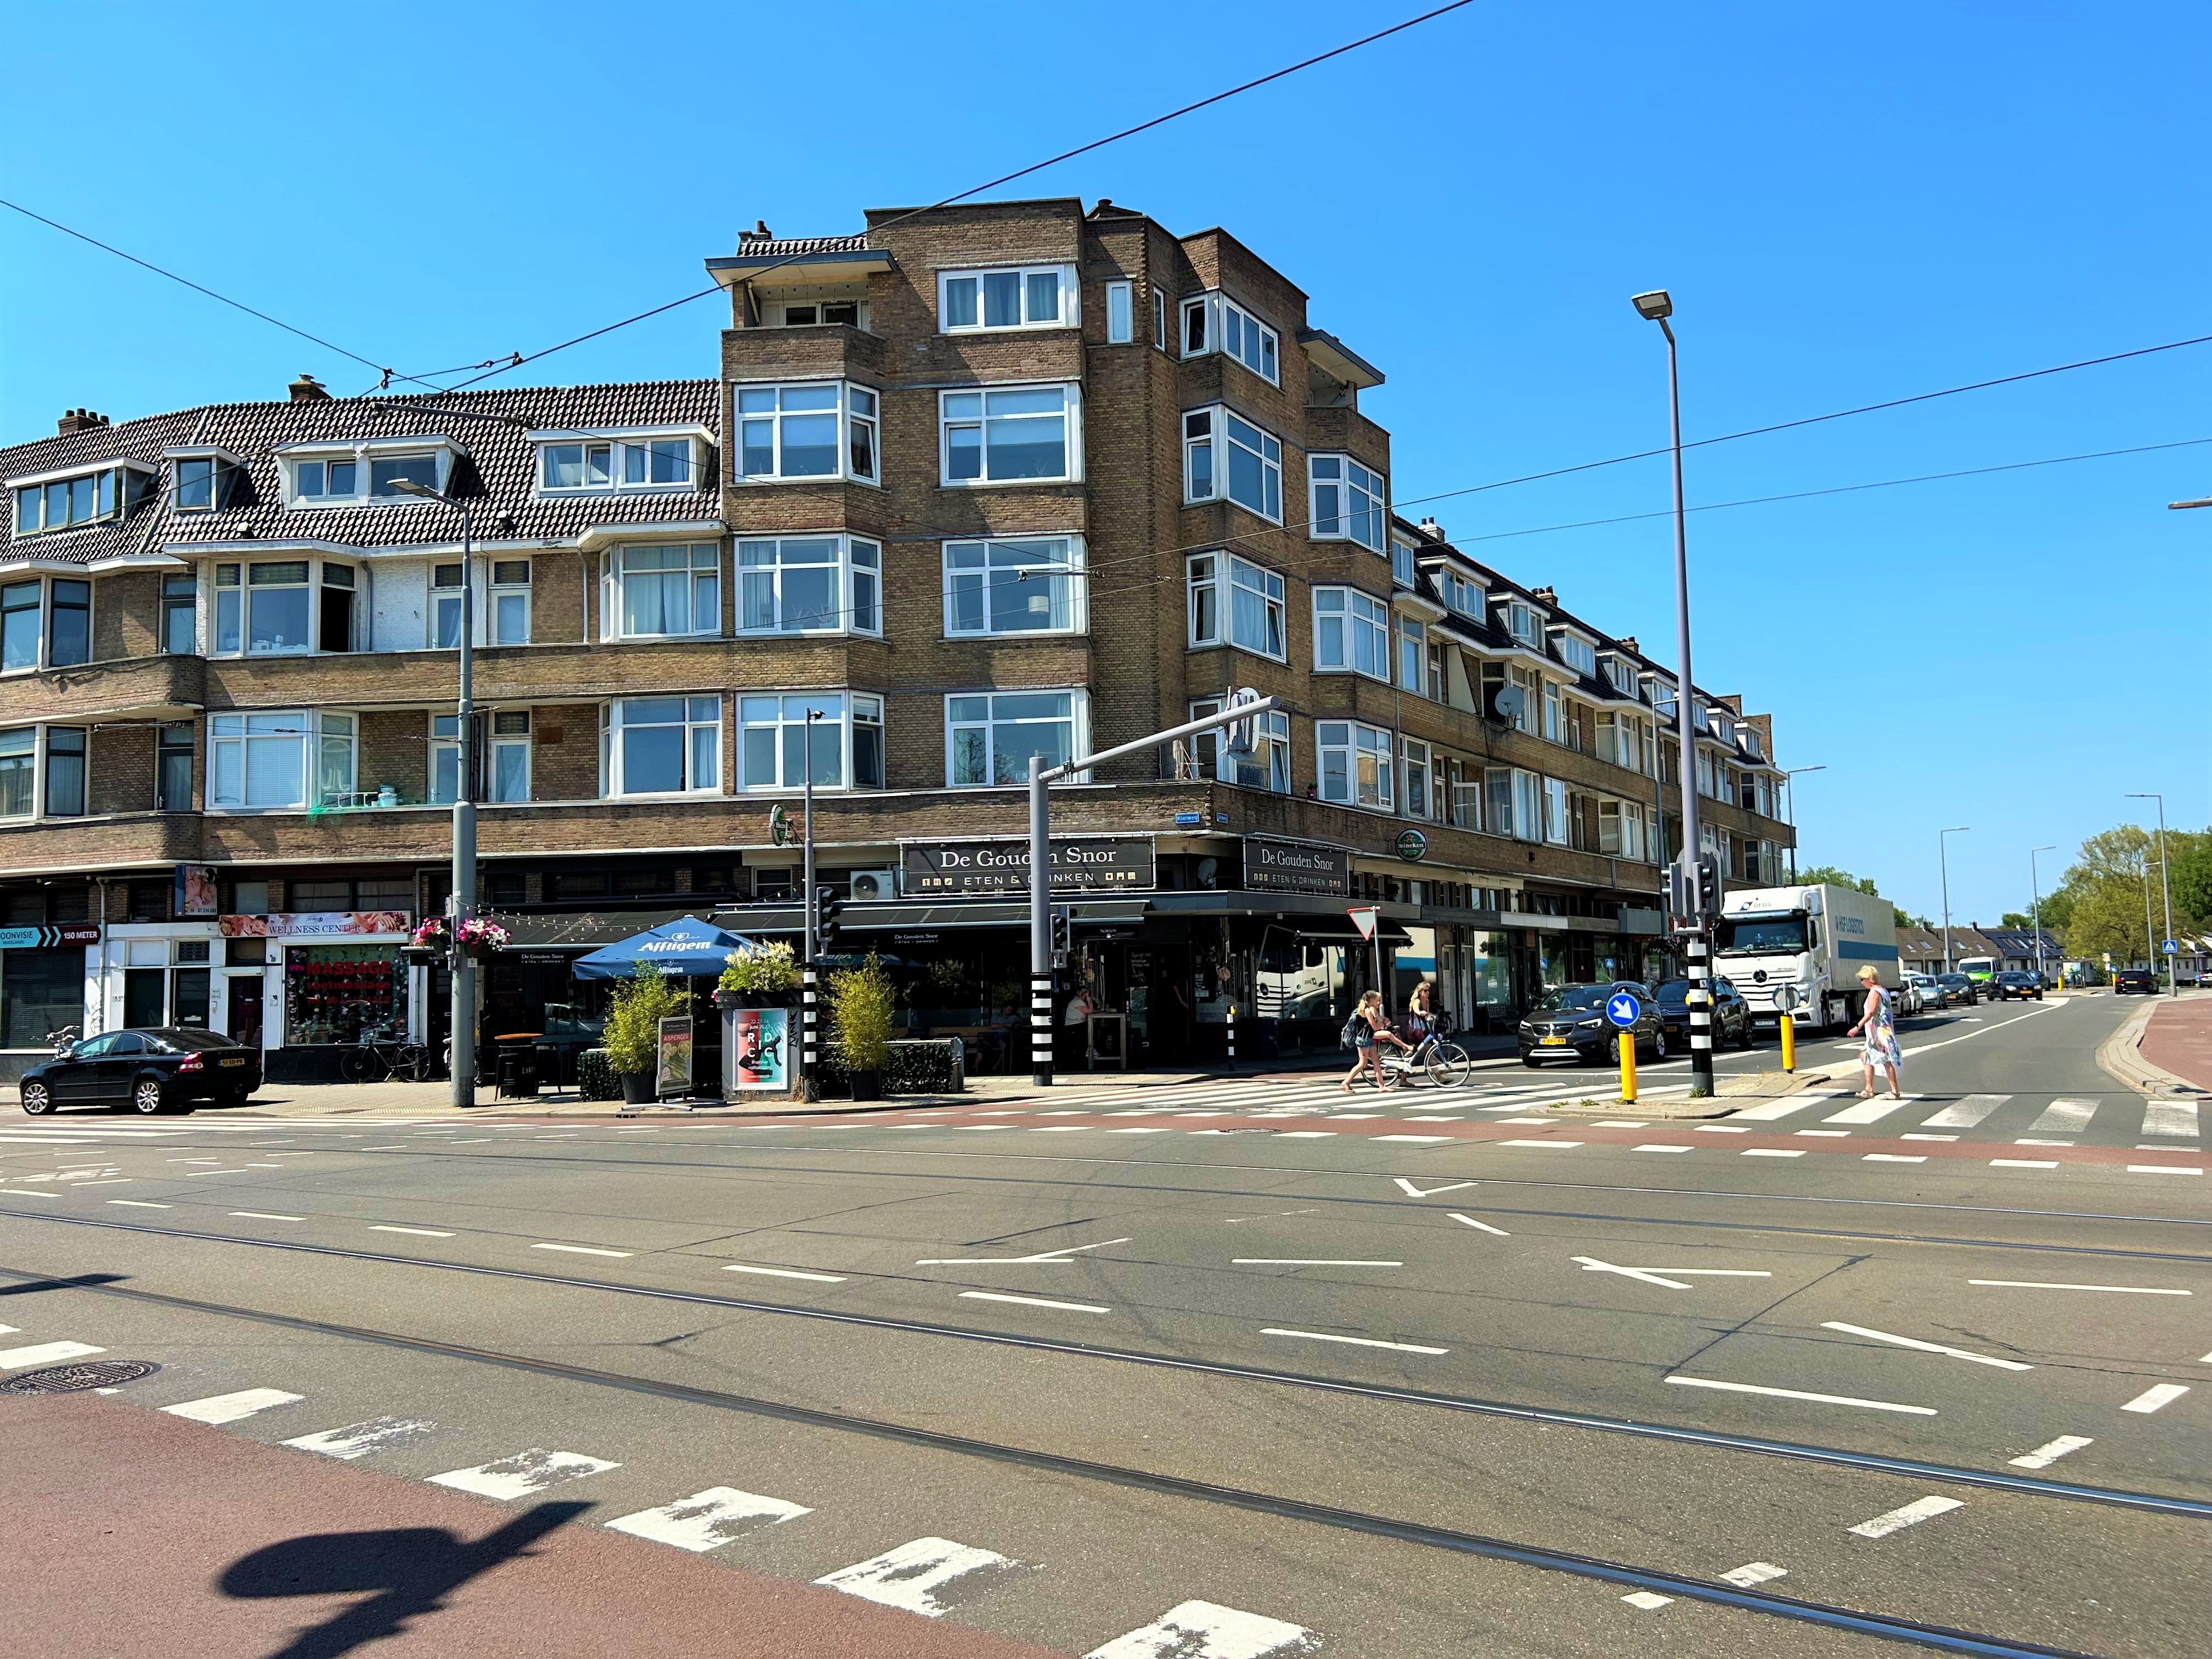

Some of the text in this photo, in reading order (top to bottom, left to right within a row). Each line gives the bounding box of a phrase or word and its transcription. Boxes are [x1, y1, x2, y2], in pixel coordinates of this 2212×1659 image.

[940, 847, 1116, 867] De Goudn Snor
[1261, 849, 1334, 871] De Gouden Snor
[964, 872, 1094, 885] ETEN & INKEN
[1272, 874, 1290, 883] ETEN
[1299, 877, 1325, 887] DRINKEN
[269, 924, 361, 934] WELLNESS CENTER
[637, 941, 712, 952] Affligem
[307, 961, 392, 975] MASSAGE
[307, 981, 391, 991] voetmassage
[663, 1034, 689, 1042] ASPERGES
[747, 1032, 772, 1042] R D
[747, 1047, 772, 1058] C C
